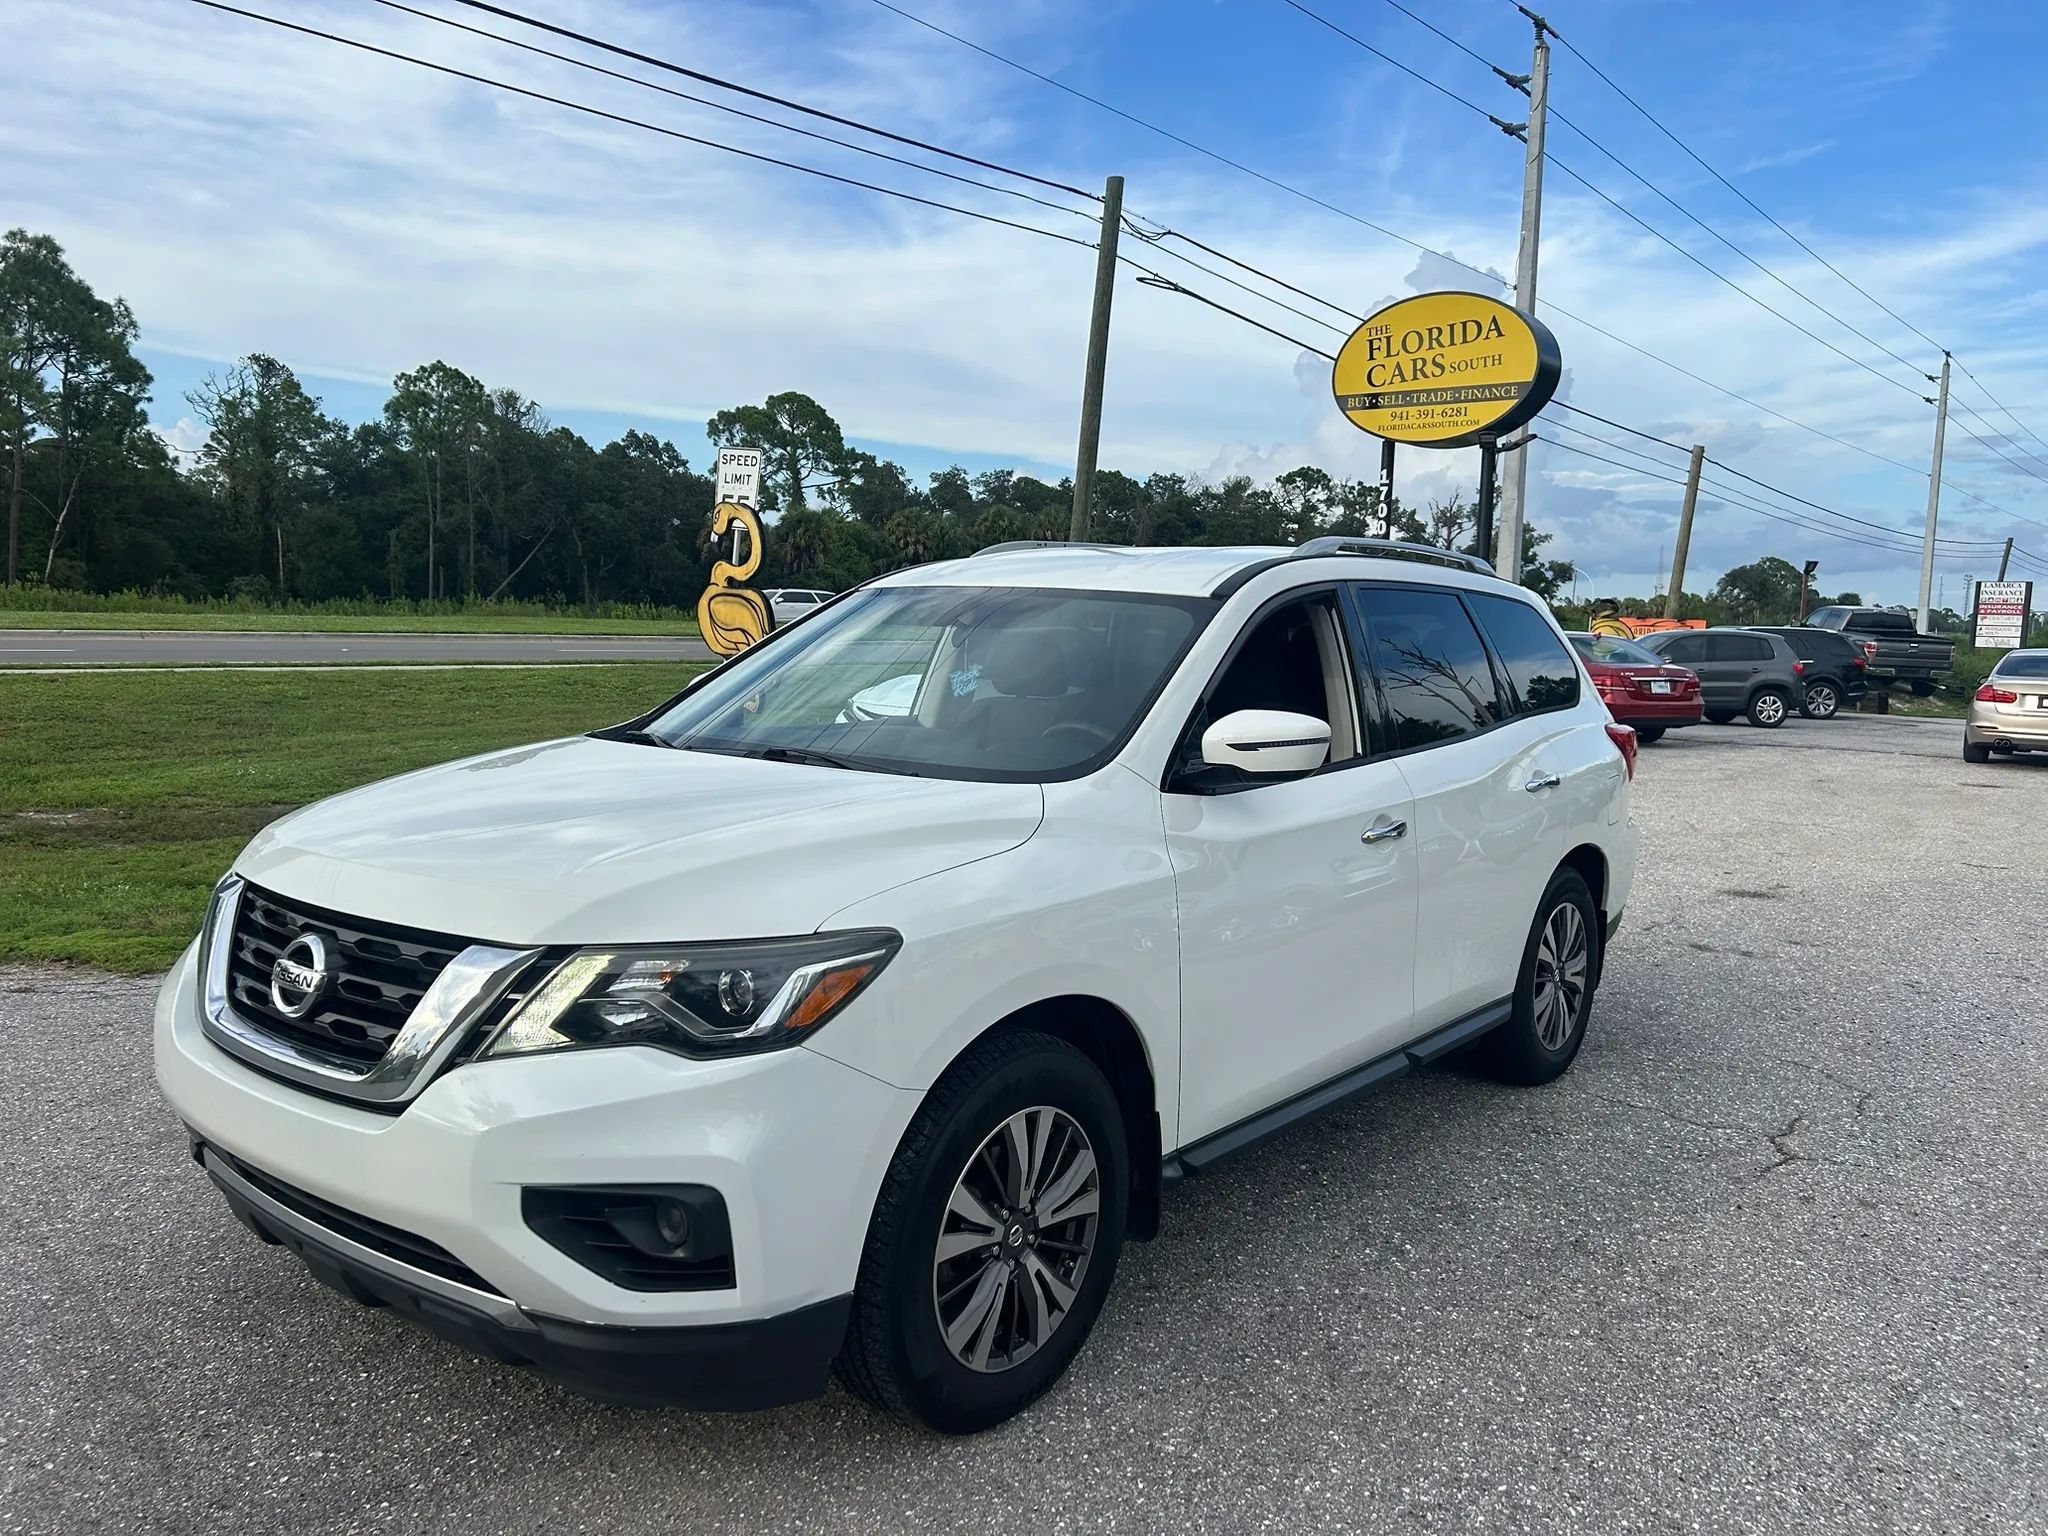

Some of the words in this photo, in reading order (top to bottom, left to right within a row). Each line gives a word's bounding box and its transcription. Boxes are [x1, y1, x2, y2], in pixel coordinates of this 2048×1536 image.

[1366, 323, 1391, 338] THE
[1366, 314, 1506, 362] FLORIDA
[1366, 353, 1446, 388] CARS
[1449, 353, 1504, 374] SOUTH
[1347, 396, 1373, 408] BUY
[1377, 394, 1405, 406] SELL
[1410, 390, 1454, 404] TRADE
[1460, 385, 1519, 400] FINANCE
[1390, 406, 1469, 422] 941-391-6281
[1377, 418, 1480, 432] FLORIDACARSSOUTH.COM
[721, 453, 758, 467] SPEED
[724, 472, 752, 485] LIMIT
